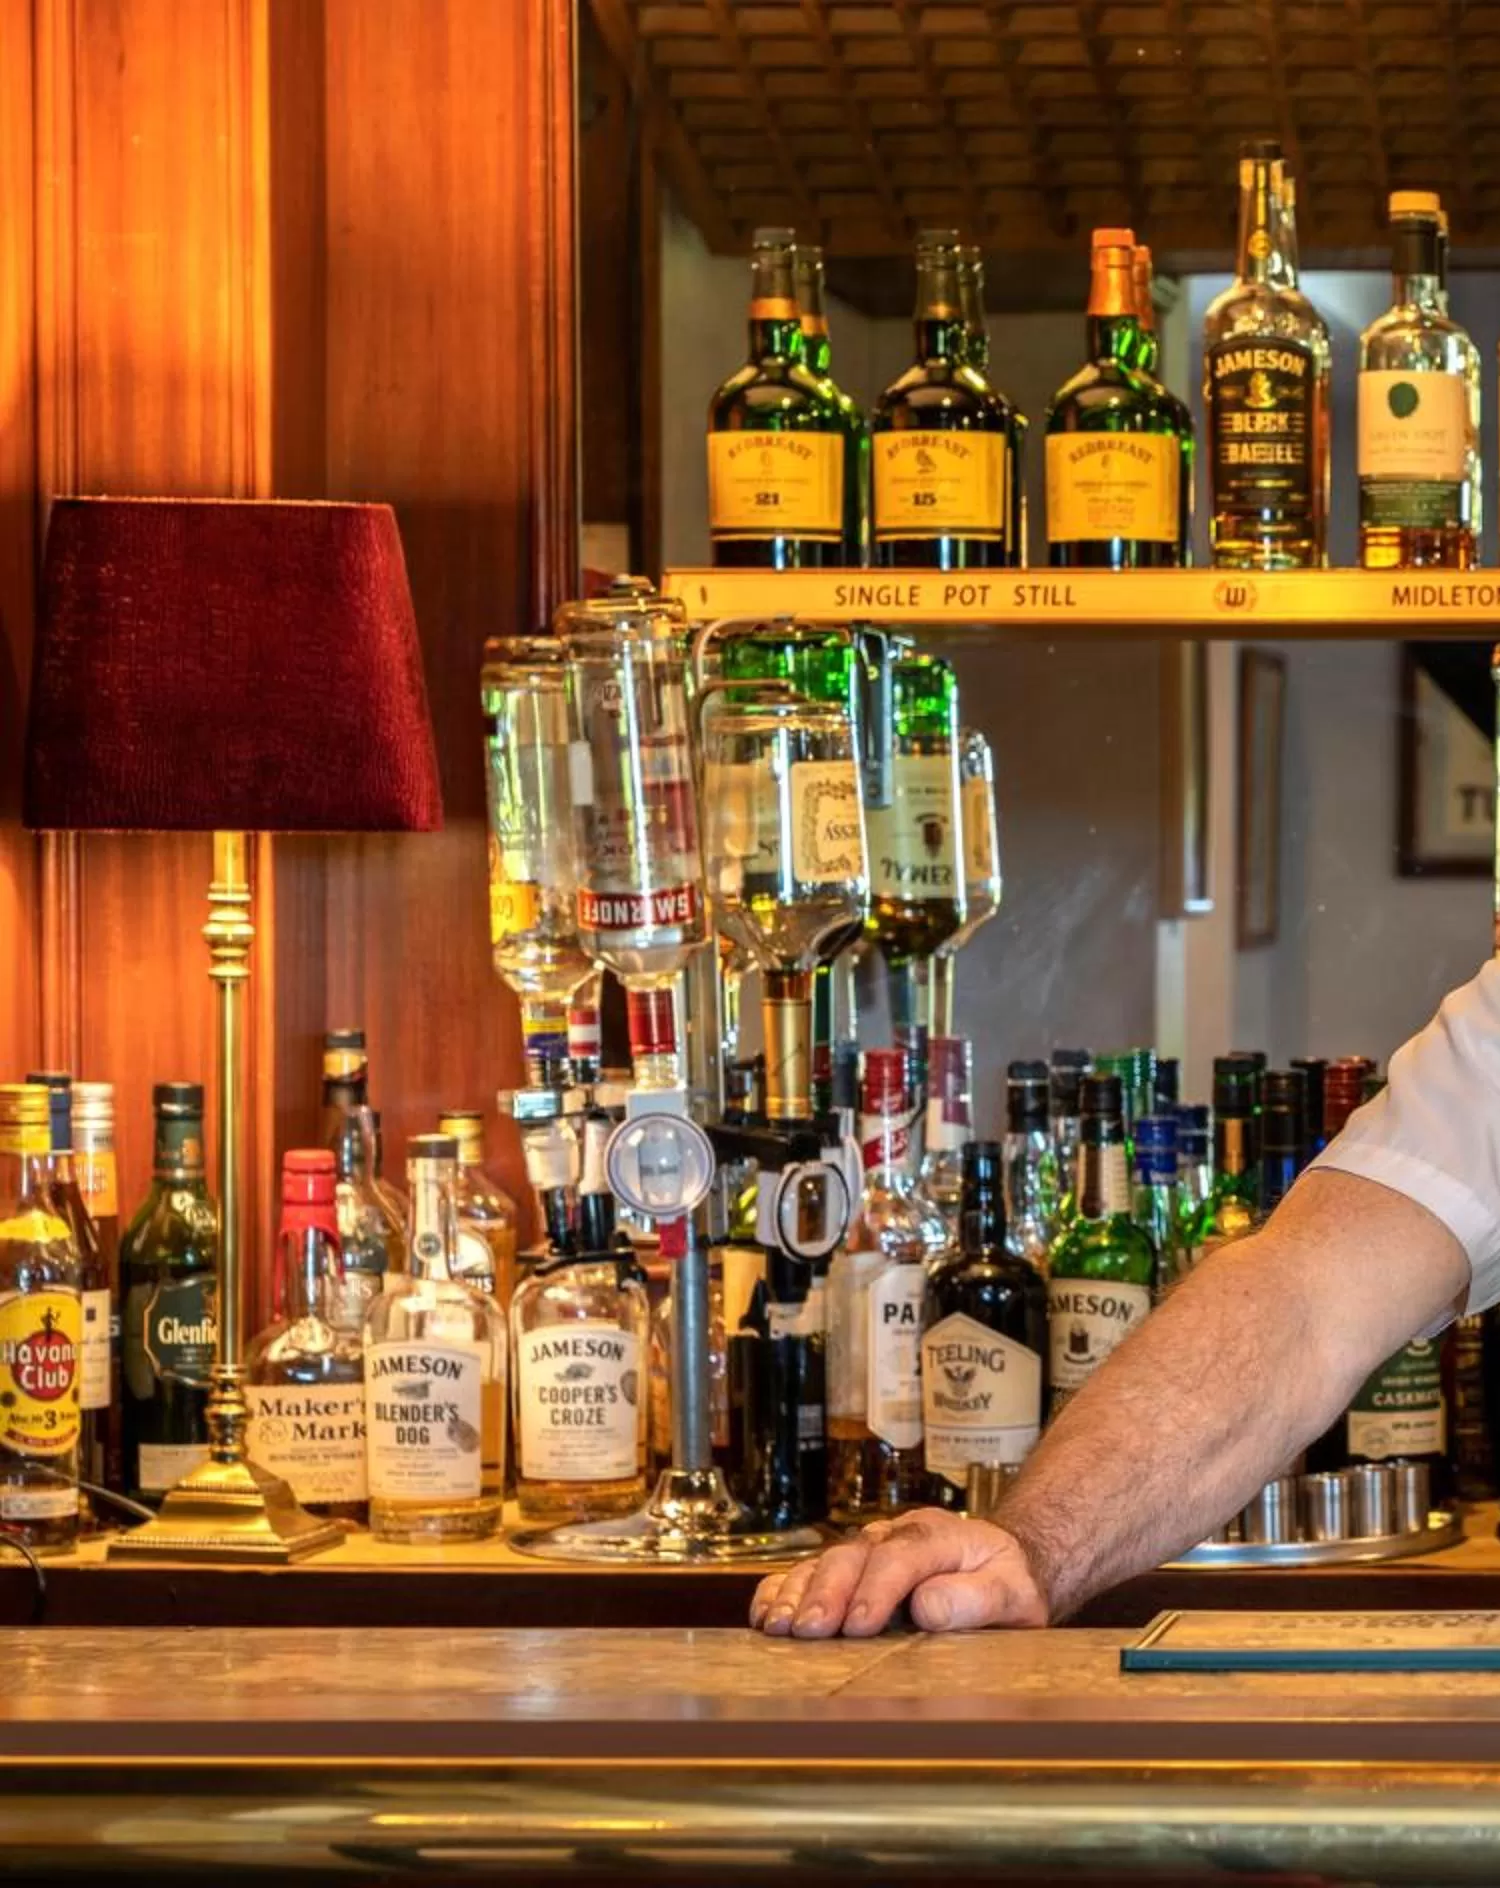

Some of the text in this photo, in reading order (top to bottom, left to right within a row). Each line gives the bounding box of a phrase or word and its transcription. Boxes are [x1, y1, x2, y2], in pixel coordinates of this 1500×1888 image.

[1215, 350, 1307, 379] JAMESON
[1231, 412, 1290, 433] BLACK
[1228, 443, 1295, 464] BARREL
[755, 492, 780, 506] 21
[913, 492, 937, 506] 15
[834, 584, 1077, 607] SINGLE POT STILL
[883, 1303, 915, 1324] PA
[1051, 1291, 1134, 1323] AMESON
[531, 1339, 625, 1363] JAMESON
[927, 1344, 1005, 1373] TEELING
[20, 1364, 70, 1390] Club
[371, 1355, 462, 1380] JAMESON
[538, 1384, 619, 1404] COOPER'S
[44, 1409, 57, 1430] 3
[375, 1400, 459, 1424] BLENDER'S
[550, 1406, 606, 1426] CROZE
[292, 1420, 367, 1441] Mark
[395, 1426, 431, 1445] DOG
